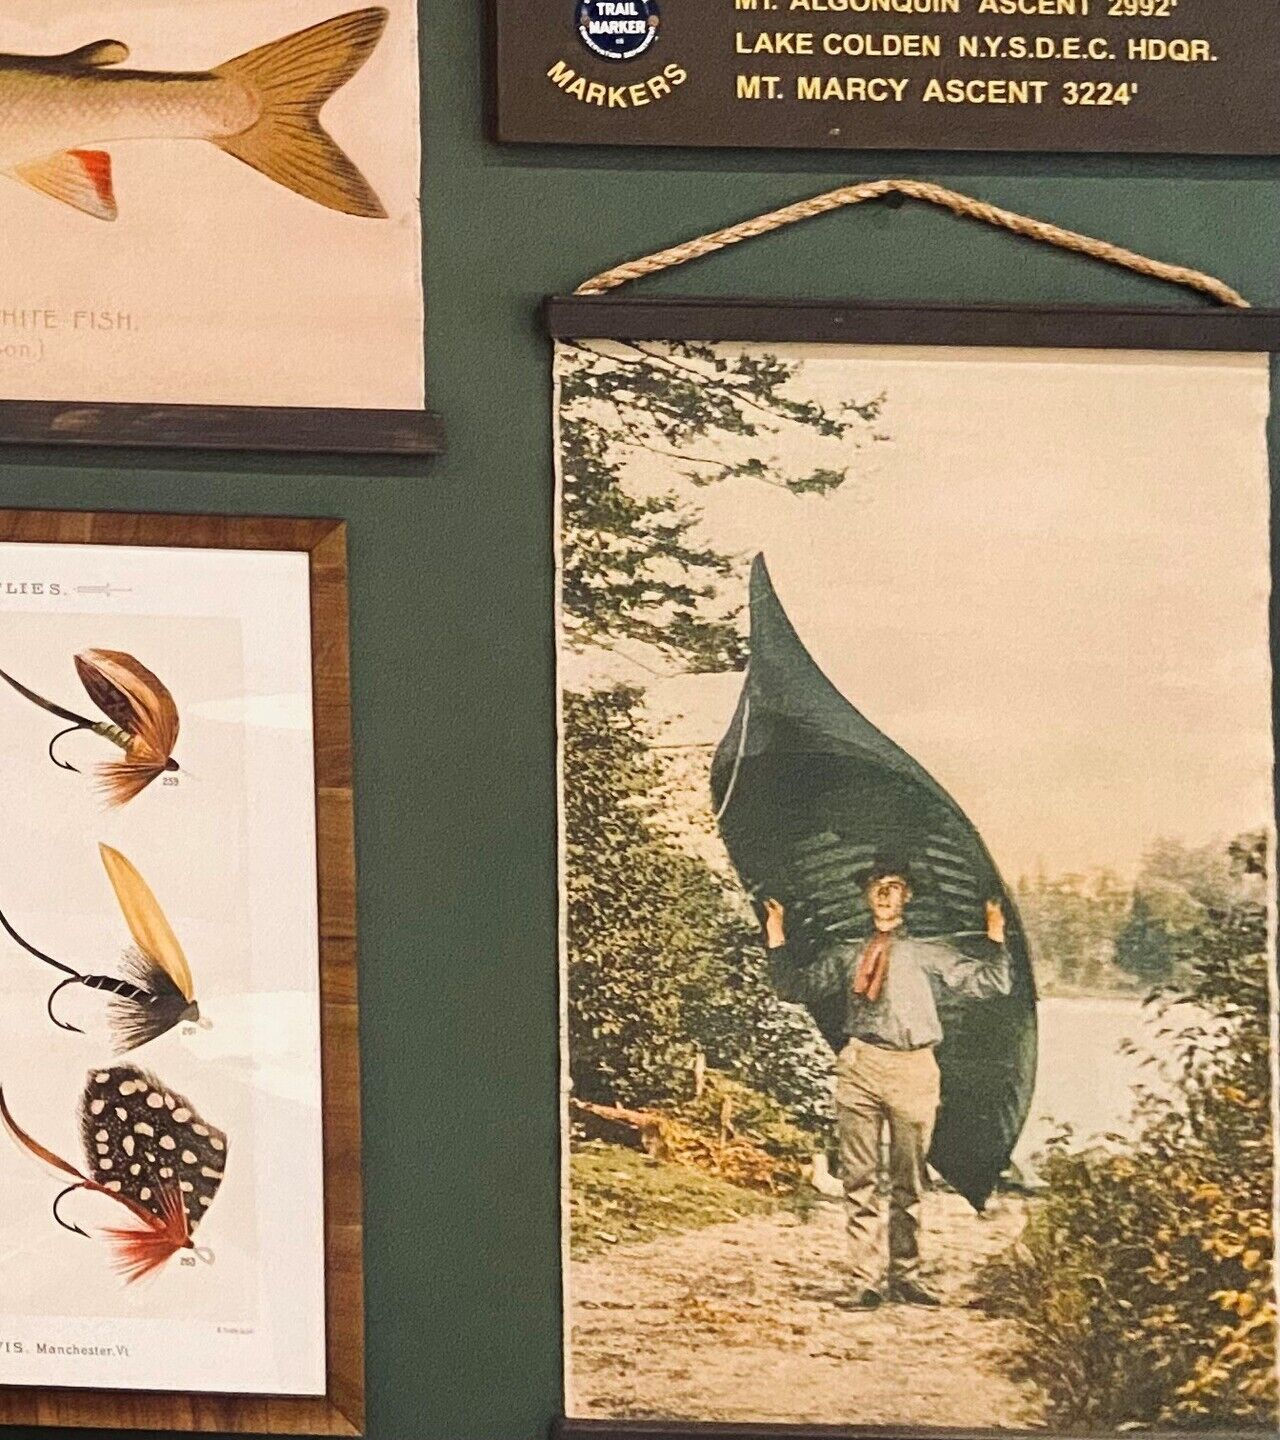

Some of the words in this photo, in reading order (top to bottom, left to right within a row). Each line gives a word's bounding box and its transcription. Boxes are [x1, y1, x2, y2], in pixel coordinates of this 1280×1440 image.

[595, 2, 639, 16] TRAIL
[588, 20, 647, 35] MARKER
[735, 31, 814, 55] LAKE
[823, 33, 941, 57] COLDEN
[958, 35, 1117, 60] N.Y.S.D.E.C.
[1127, 38, 1218, 62] HDQR.
[546, 60, 688, 109] MARKERS
[736, 75, 784, 100] MT.
[797, 76, 910, 102] MARCY
[922, 78, 1049, 105] ASCENT
[1062, 81, 1139, 106] 3224'
